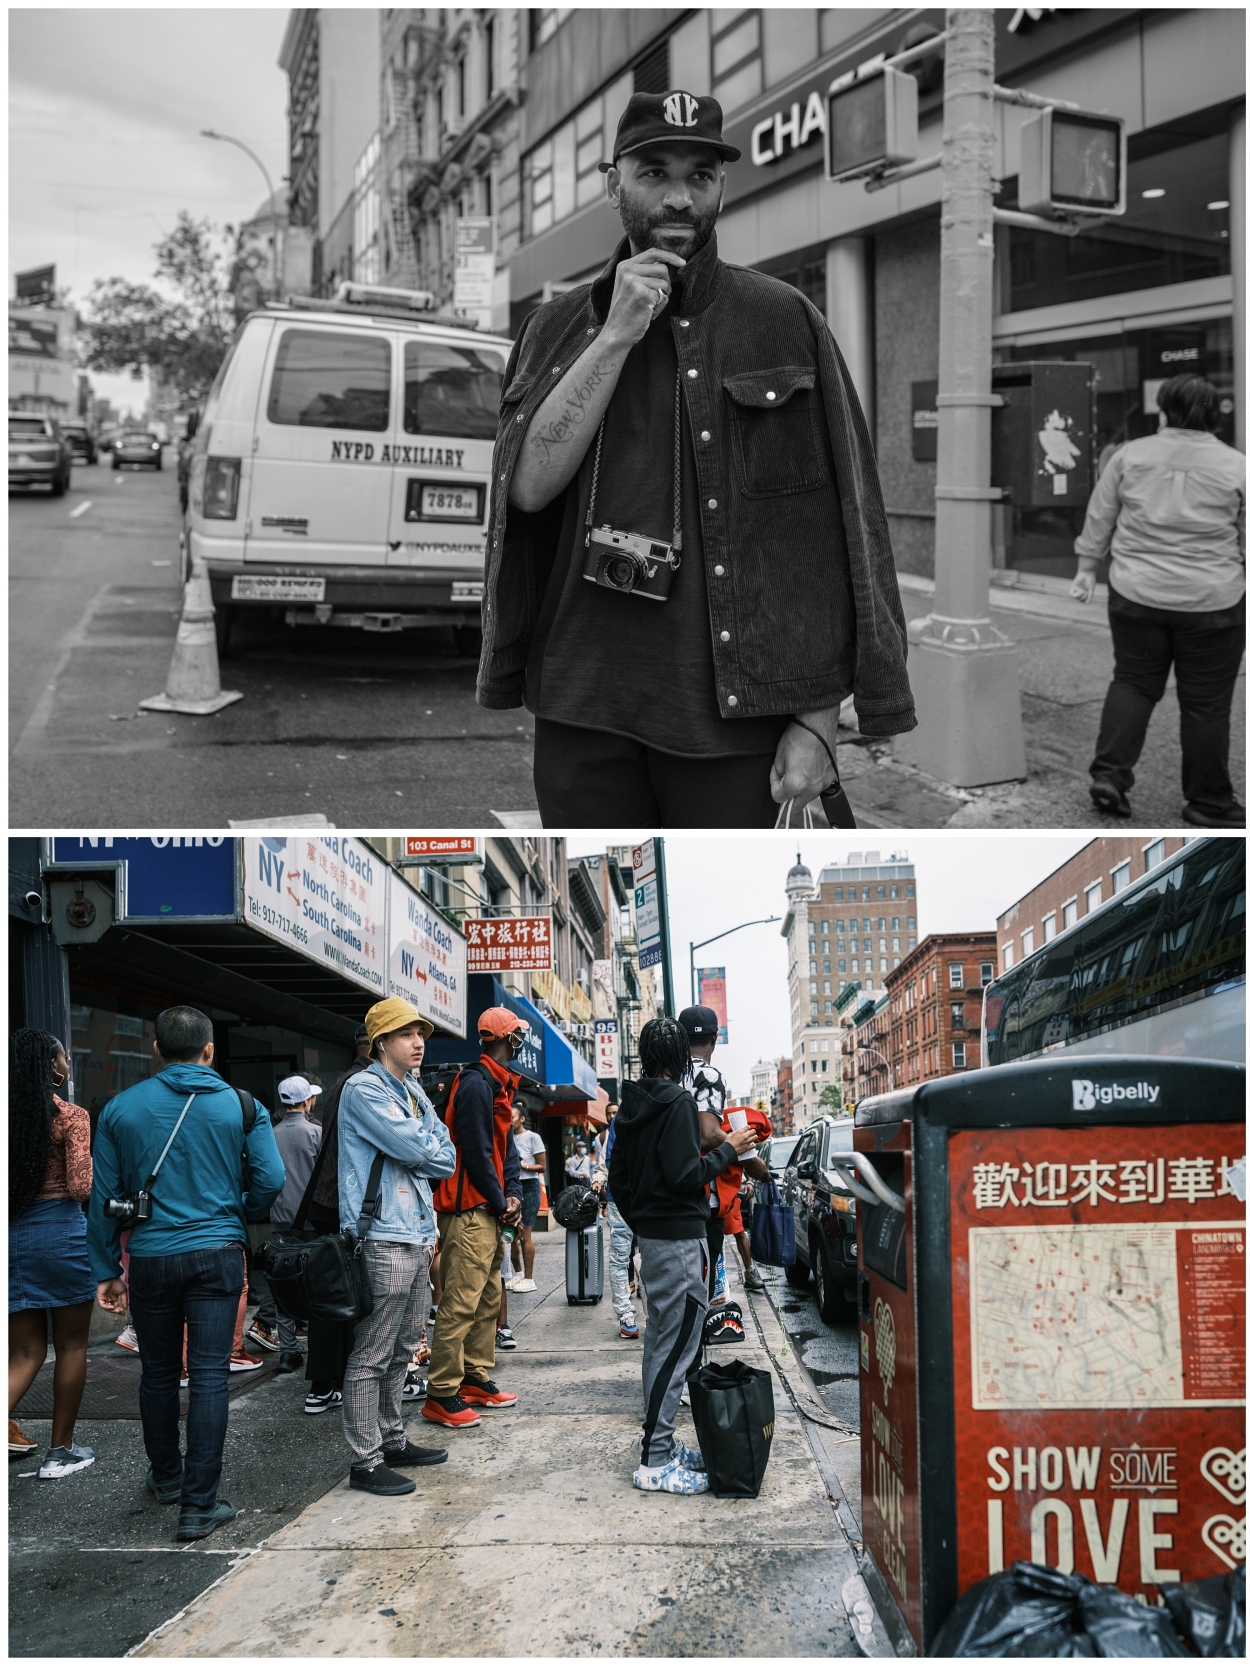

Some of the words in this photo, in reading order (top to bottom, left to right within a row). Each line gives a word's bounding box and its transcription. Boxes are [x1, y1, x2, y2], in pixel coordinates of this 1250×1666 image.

[663, 92, 699, 126] NY
[1160, 348, 1199, 362] CHASE
[331, 440, 374, 461] NYPD
[381, 444, 465, 467] AUXILIARY
[341, 837, 373, 886] Coach
[409, 841, 428, 851] 103
[429, 840, 459, 851] Canal
[460, 839, 472, 849] St
[259, 843, 285, 894] NY
[303, 868, 329, 903] North
[331, 890, 362, 927] Carolina
[248, 895, 262, 918] Tel:
[262, 904, 308, 945] 917-717-4666
[303, 898, 329, 931] South
[331, 918, 362, 952] Carolina
[407, 897, 432, 938] Wanda
[433, 921, 453, 954] Coach
[467, 920, 550, 946] 宏中旅行社
[401, 949, 414, 979] NY
[428, 960, 450, 990] Atlanta,
[449, 975, 457, 992] GA
[596, 1022, 617, 1034] 95
[600, 1034, 613, 1070] BUS
[1071, 1079, 1160, 1111] Bigbelly
[1191, 1232, 1243, 1244] CHINATOWN
[872, 1400, 892, 1453] SHOW
[987, 1446, 1102, 1492] SHOW
[1110, 1453, 1177, 1484] SOME
[872, 1439, 907, 1558] LOVE
